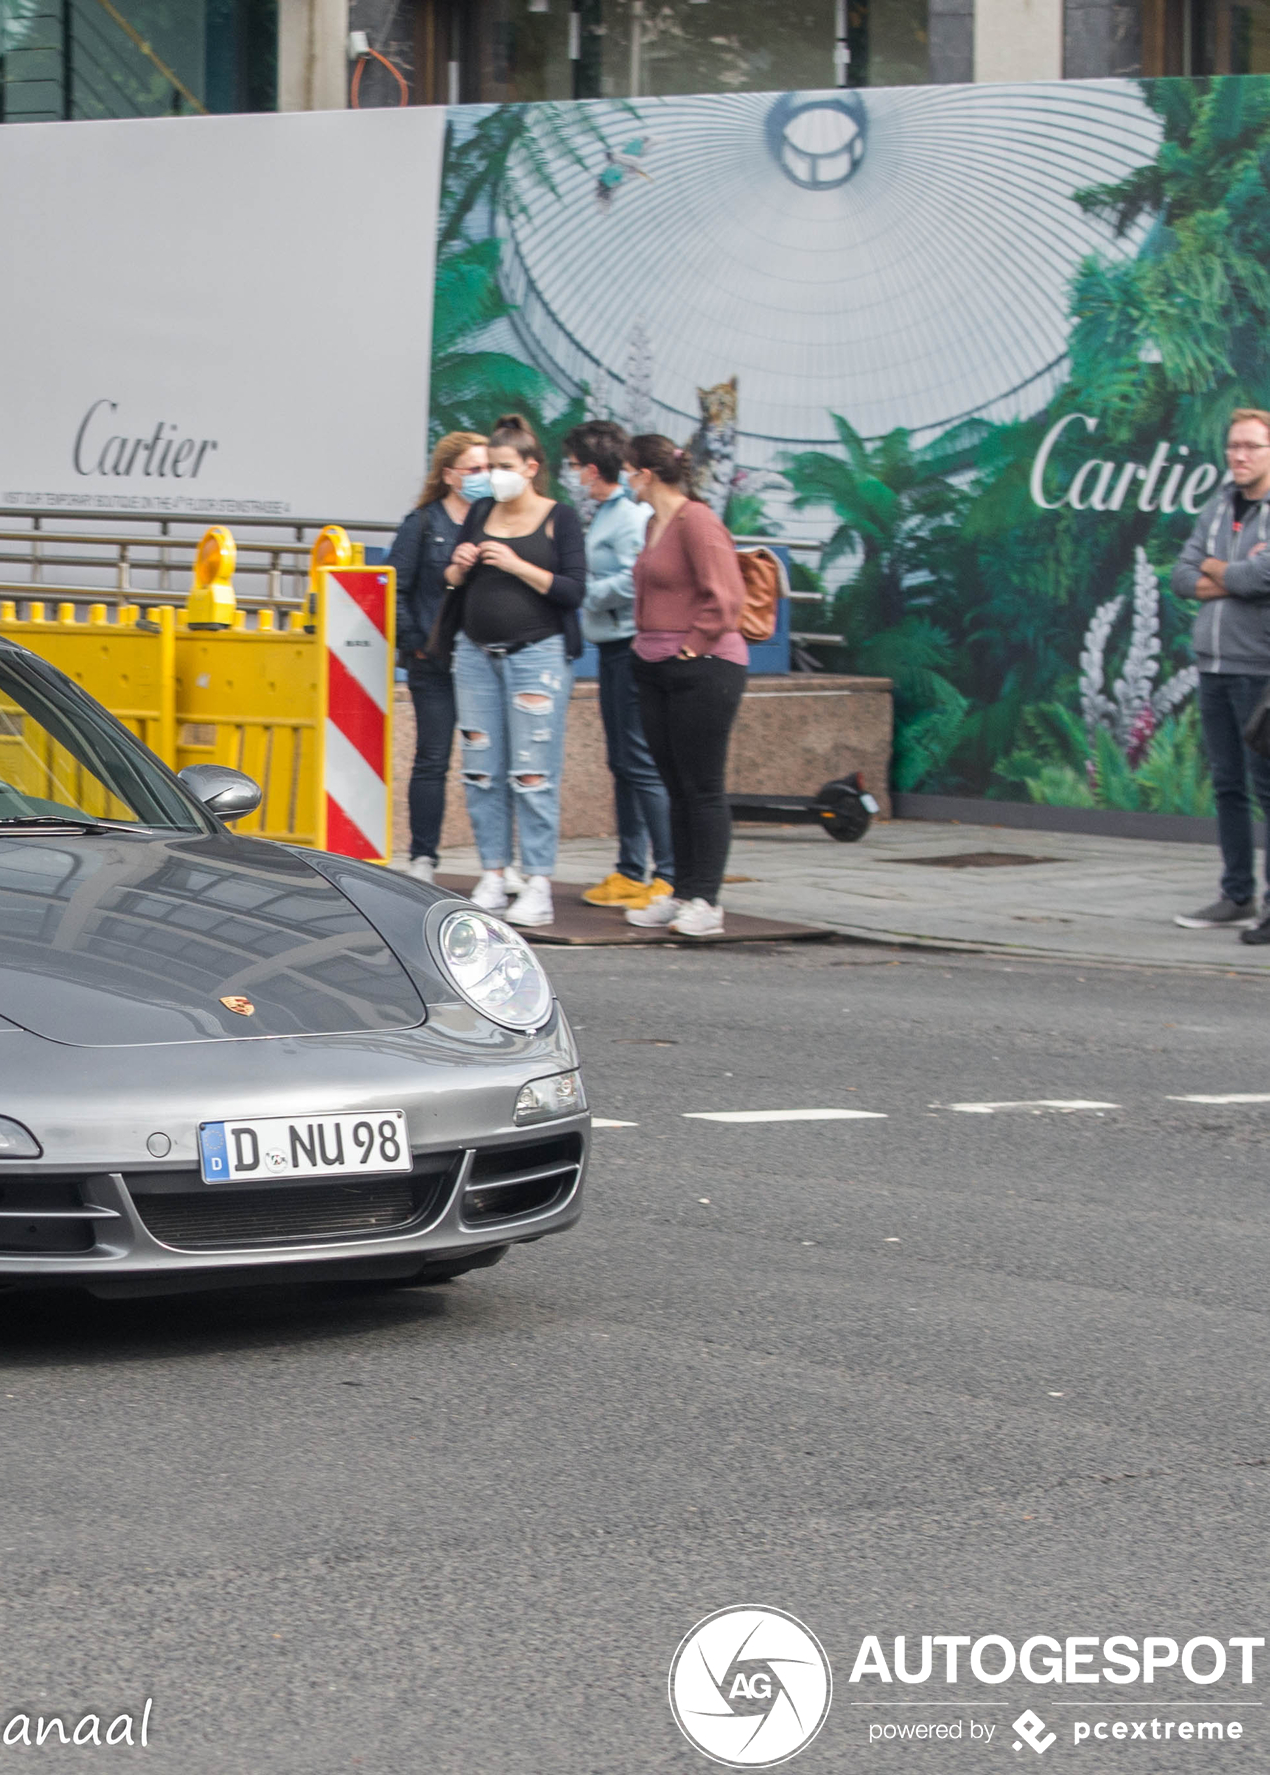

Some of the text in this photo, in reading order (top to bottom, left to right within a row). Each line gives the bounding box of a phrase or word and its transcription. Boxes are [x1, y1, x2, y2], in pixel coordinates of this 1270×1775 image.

[73, 399, 218, 478] Cartier
[1031, 412, 1233, 514] Cartie
[211, 1157, 223, 1171] D
[231, 1127, 261, 1172] D
